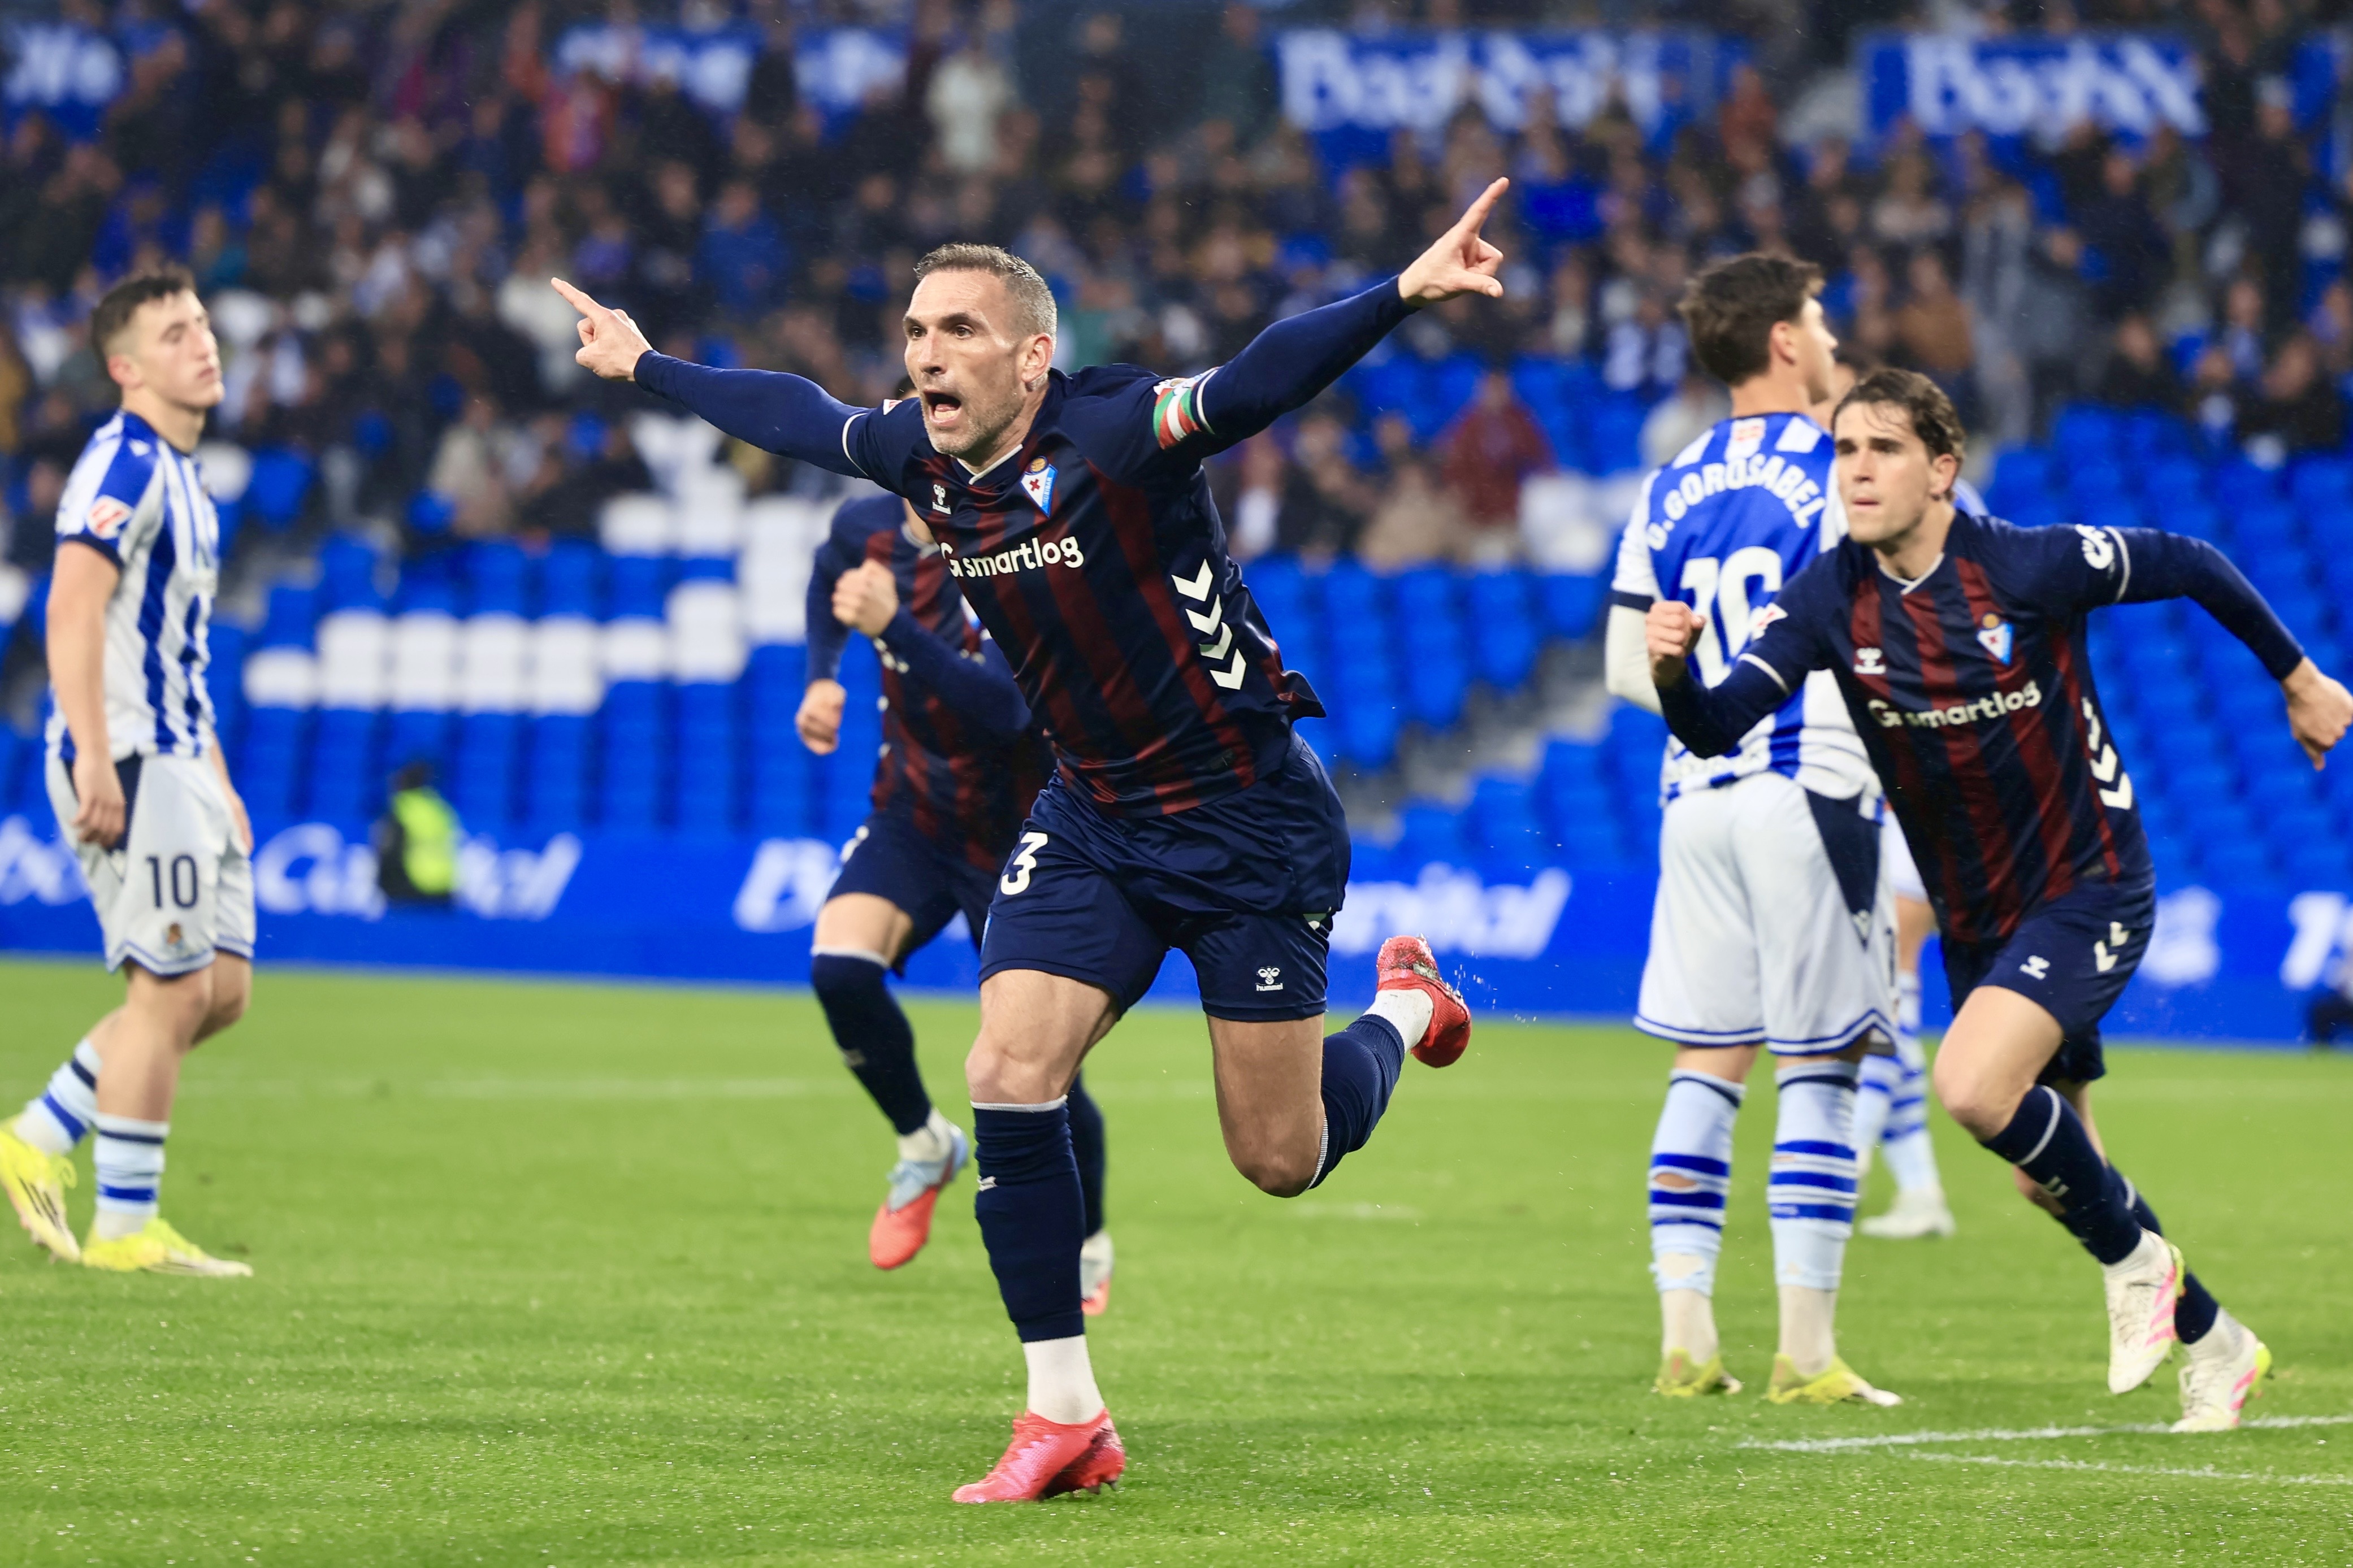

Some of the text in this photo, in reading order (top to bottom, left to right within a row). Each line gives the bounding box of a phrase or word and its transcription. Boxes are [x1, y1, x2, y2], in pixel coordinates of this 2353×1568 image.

[962, 536, 1085, 577] smartlog
[145, 854, 199, 909] 10
[1000, 831, 1048, 896] 3
